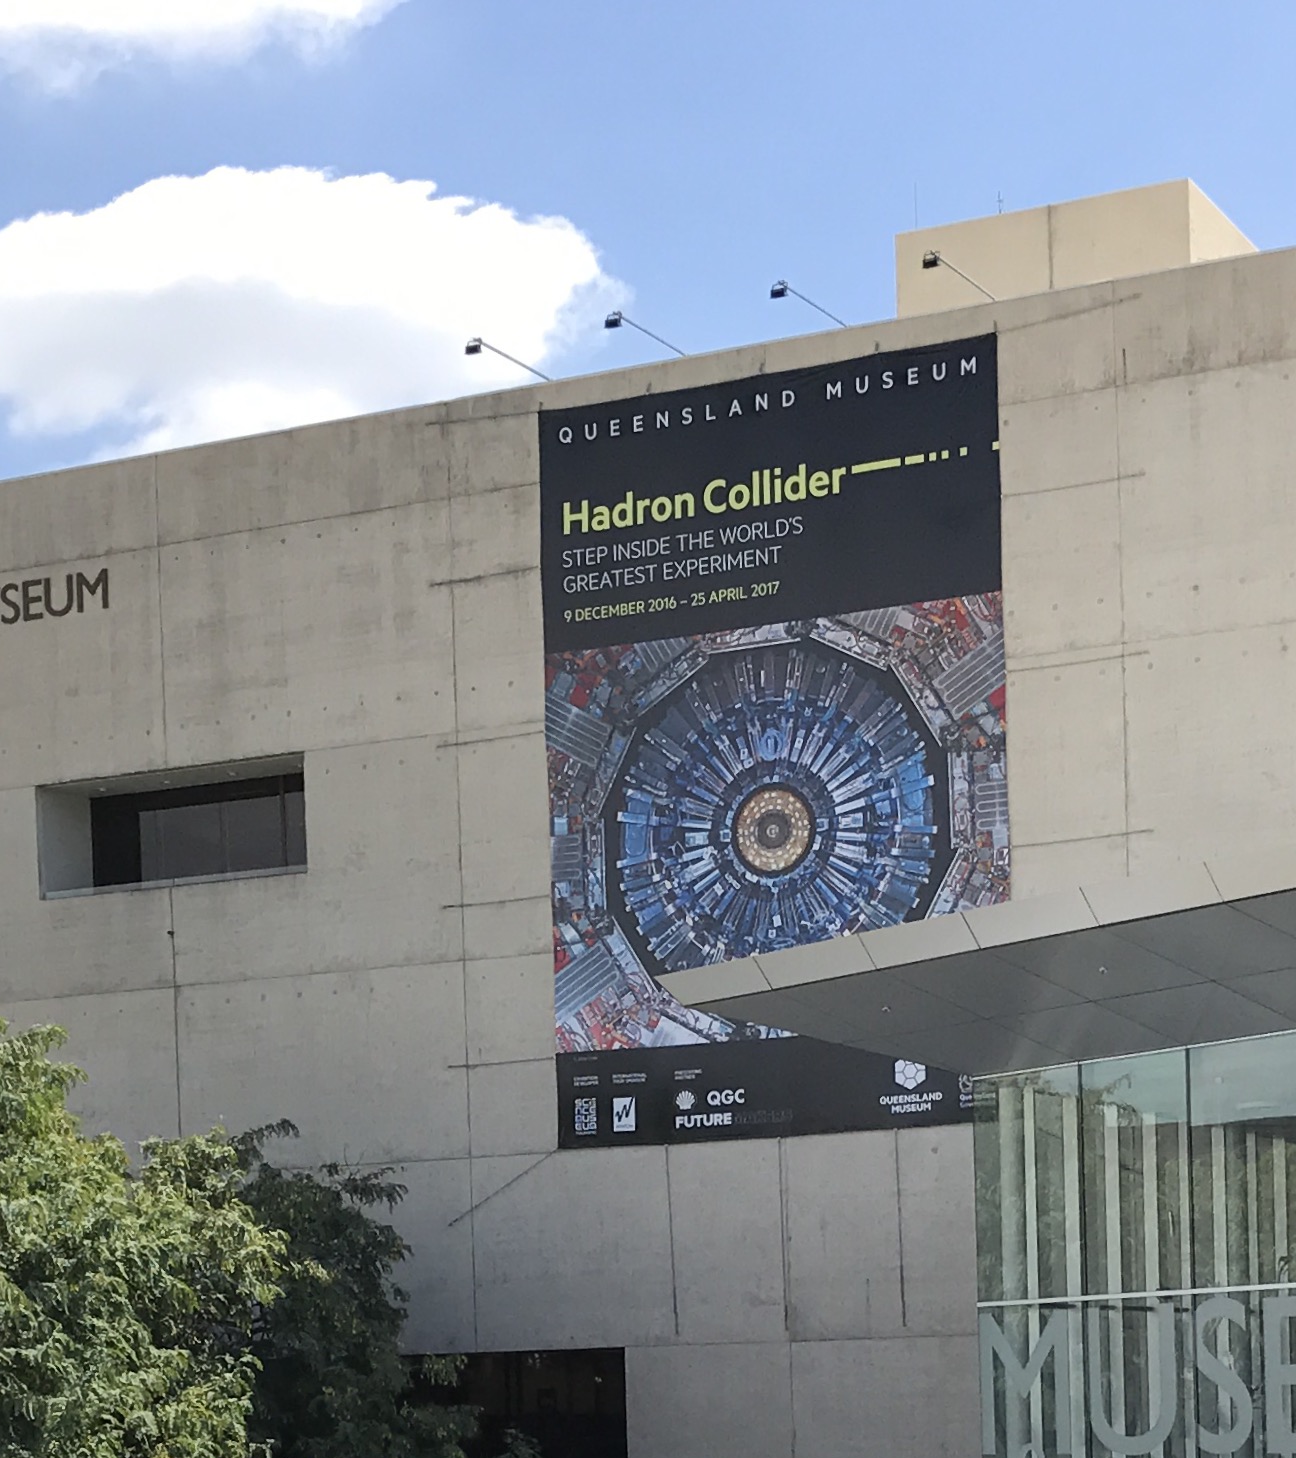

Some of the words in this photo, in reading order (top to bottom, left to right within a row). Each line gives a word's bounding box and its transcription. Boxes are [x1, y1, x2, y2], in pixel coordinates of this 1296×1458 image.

[558, 389, 796, 444] QUEENSLAND
[825, 356, 977, 400] MUSEUM
[561, 490, 695, 535] Hadron
[703, 463, 846, 514] Collider
[561, 546, 608, 569] STEP
[612, 535, 671, 562] INSIDE
[675, 528, 714, 553] THE
[718, 515, 804, 546] WORLD'S
[562, 564, 657, 595] GREATEST
[662, 545, 782, 581] EXPERIMENT
[563, 610, 573, 623] 9
[573, 599, 646, 622] DECEMBER
[647, 596, 678, 613] 2016
[690, 591, 706, 607] 25
[708, 586, 748, 606] APRIL
[750, 580, 780, 599] 2017
[707, 1088, 745, 1107] QGC
[879, 1091, 943, 1106] QUEENSLAND
[891, 1102, 932, 1114] MUSEUM
[675, 1112, 733, 1130] FUTURE
